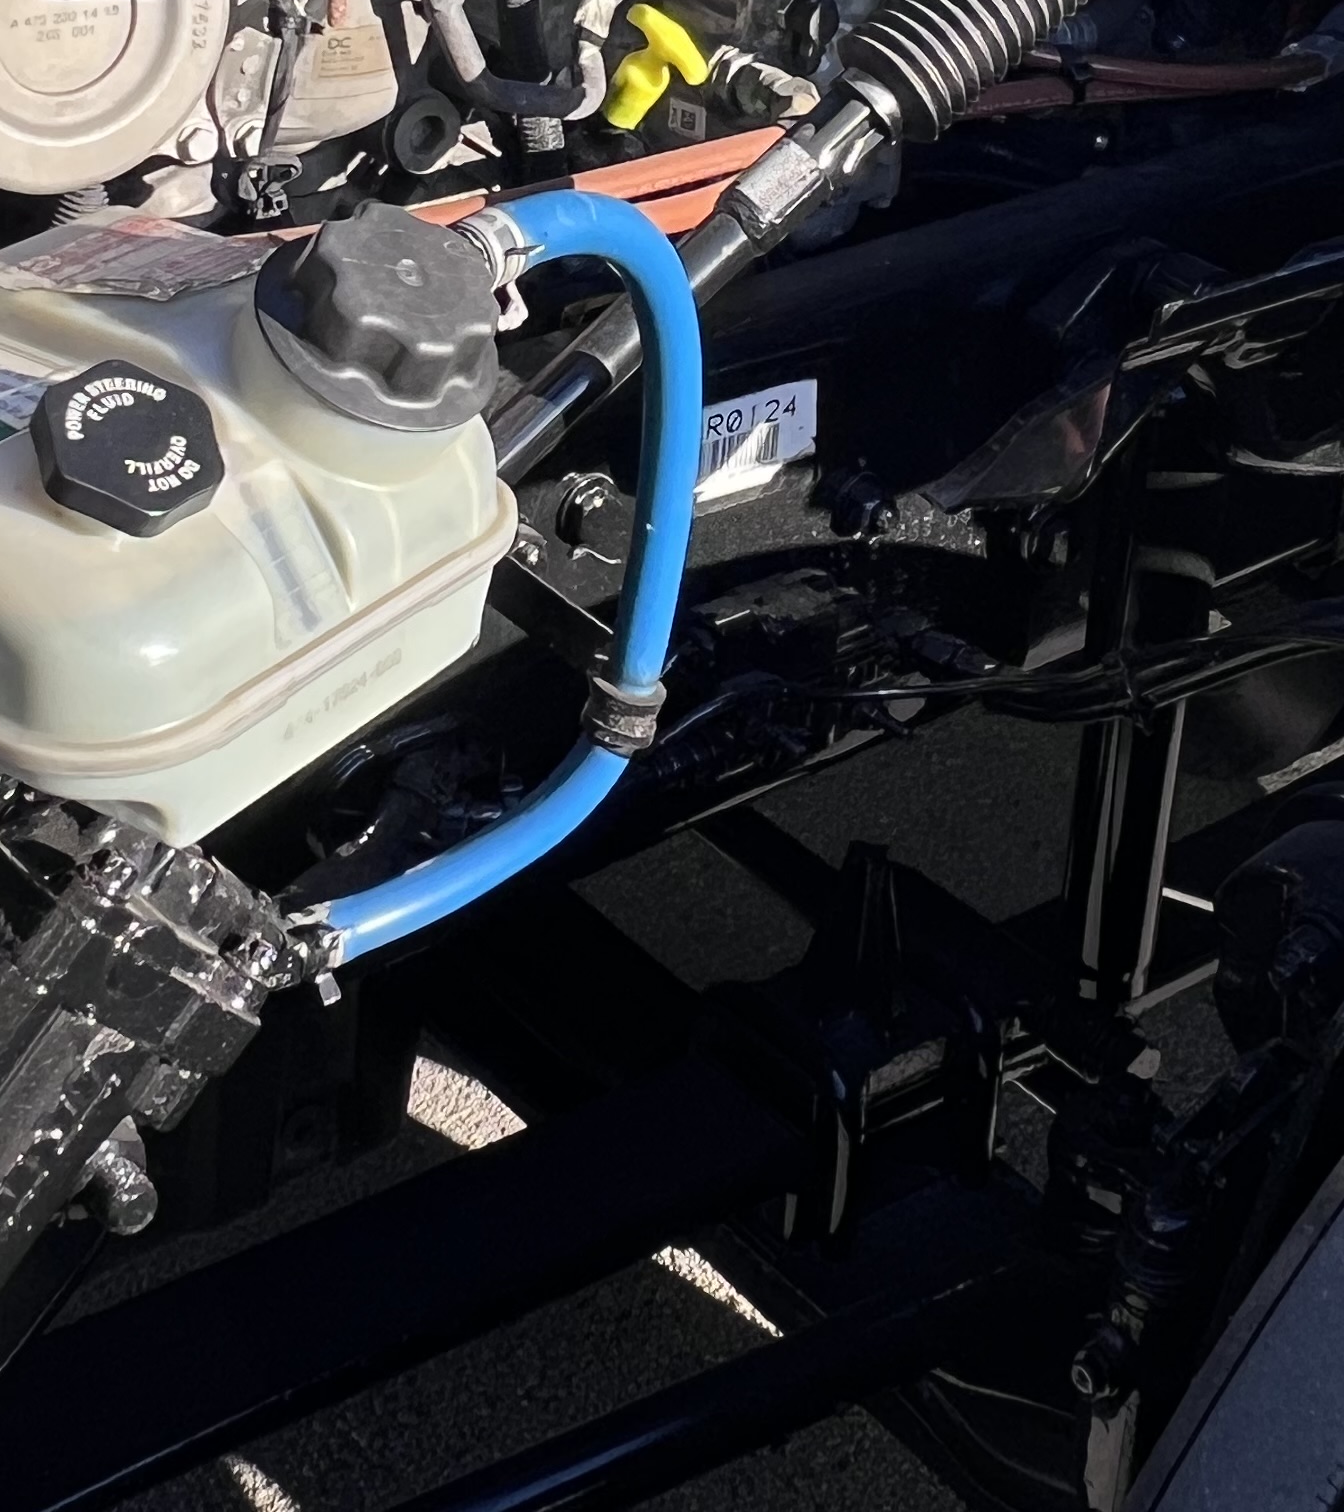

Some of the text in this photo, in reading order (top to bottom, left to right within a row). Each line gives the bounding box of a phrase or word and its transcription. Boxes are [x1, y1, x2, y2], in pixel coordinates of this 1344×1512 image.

[65, 377, 167, 440] POWER STEERING
[86, 392, 135, 421] FLUID
[124, 435, 187, 475] OVERFILL
[148, 459, 201, 493] DO NOT
